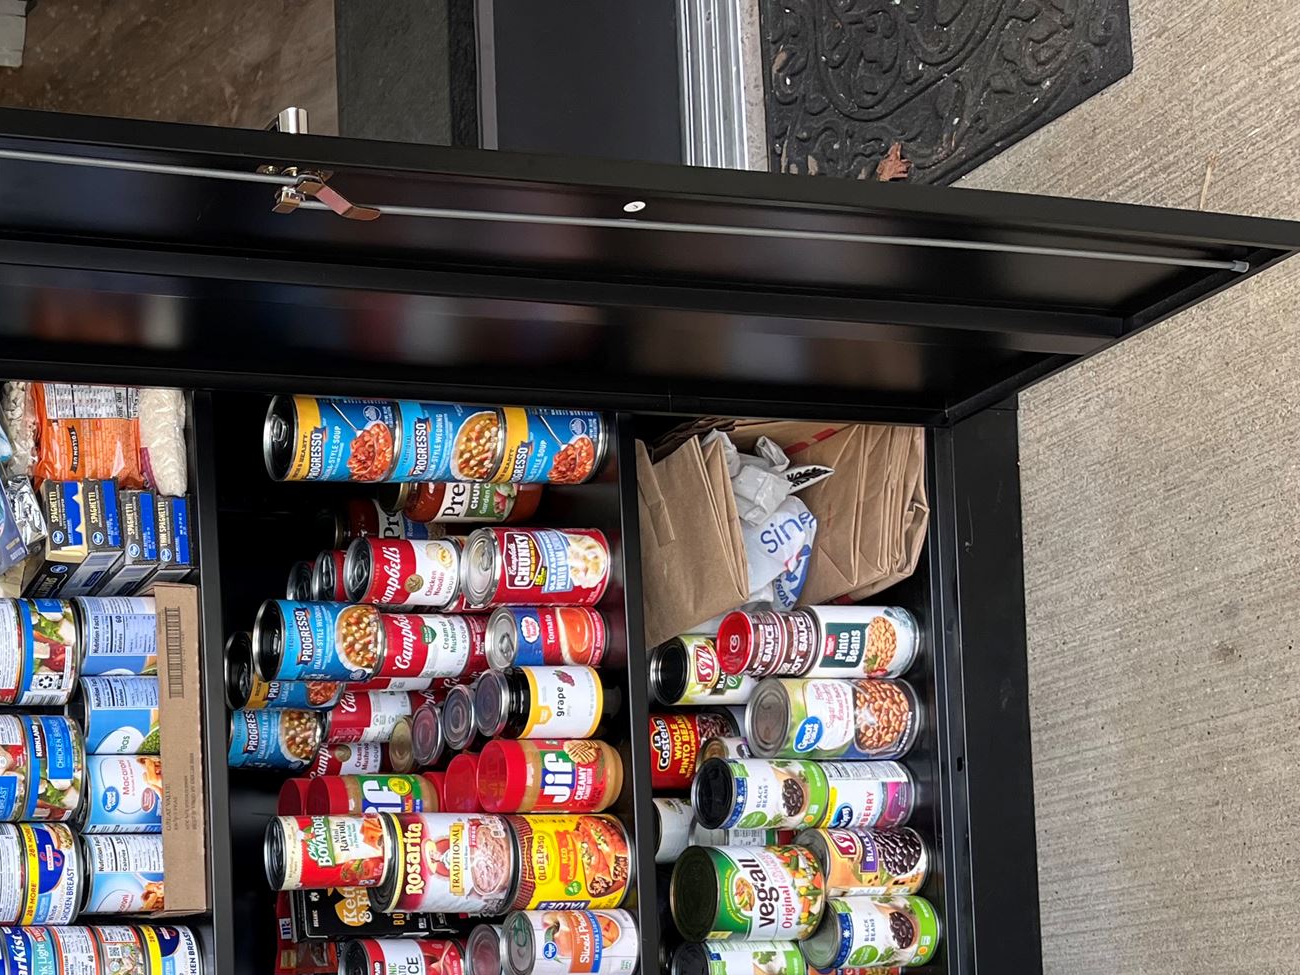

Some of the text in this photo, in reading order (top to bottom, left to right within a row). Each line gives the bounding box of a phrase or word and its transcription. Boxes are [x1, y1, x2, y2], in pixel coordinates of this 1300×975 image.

[333, 426, 341, 443] SOUP
[413, 423, 427, 475] PROGRESSO
[538, 439, 547, 457] SOUP
[49, 491, 59, 523] SPAGHETTI
[89, 492, 98, 523] SPAGHETTI
[158, 501, 167, 532] SPAGHETTI
[479, 490, 490, 514] Garden
[125, 503, 135, 535] SPAGHETTI
[514, 535, 530, 586] CHUNKY
[555, 551, 567, 590] POTATO HAM
[425, 570, 437, 597] Chicken
[432, 572, 444, 596] Noodle
[92, 615, 100, 653] Nutrition Facts
[115, 615, 122, 624] 60
[545, 614, 555, 644] Tomato
[793, 616, 807, 652] SAUCE
[294, 611, 313, 661] PROGRESSO
[315, 628, 324, 669] ITALIAN-STYLE
[441, 629, 449, 650] Cream
[762, 625, 774, 662] SAUCE
[833, 631, 850, 660] Pinto
[847, 630, 862, 663] Beans
[555, 686, 566, 717] grape
[33, 725, 43, 757] KIRKLAND
[653, 736, 662, 746] La
[655, 718, 670, 767] Costeña
[670, 724, 682, 759] WHOLE
[800, 723, 813, 749] Great
[55, 739, 64, 768] CHICKEN
[679, 745, 690, 774] PINTO
[118, 759, 130, 795] Macaroni
[543, 753, 572, 803] Jif
[575, 767, 587, 800] CREAMY
[308, 842, 317, 861] Chef
[337, 821, 350, 852] Ravioli
[860, 837, 875, 862] BLACK
[96, 847, 105, 872] Nutrition
[403, 823, 425, 895] Rosarita
[451, 828, 461, 889] TRADITIONAL
[538, 865, 547, 880] OLD
[61, 868, 74, 921] CHICKEN BREAST
[779, 885, 796, 929] Original
[48, 905, 58, 921] White
[182, 931, 195, 955] BREAST
[868, 918, 876, 942] BEANS
[35, 943, 50, 964] Light
[579, 934, 590, 963] Sliced
